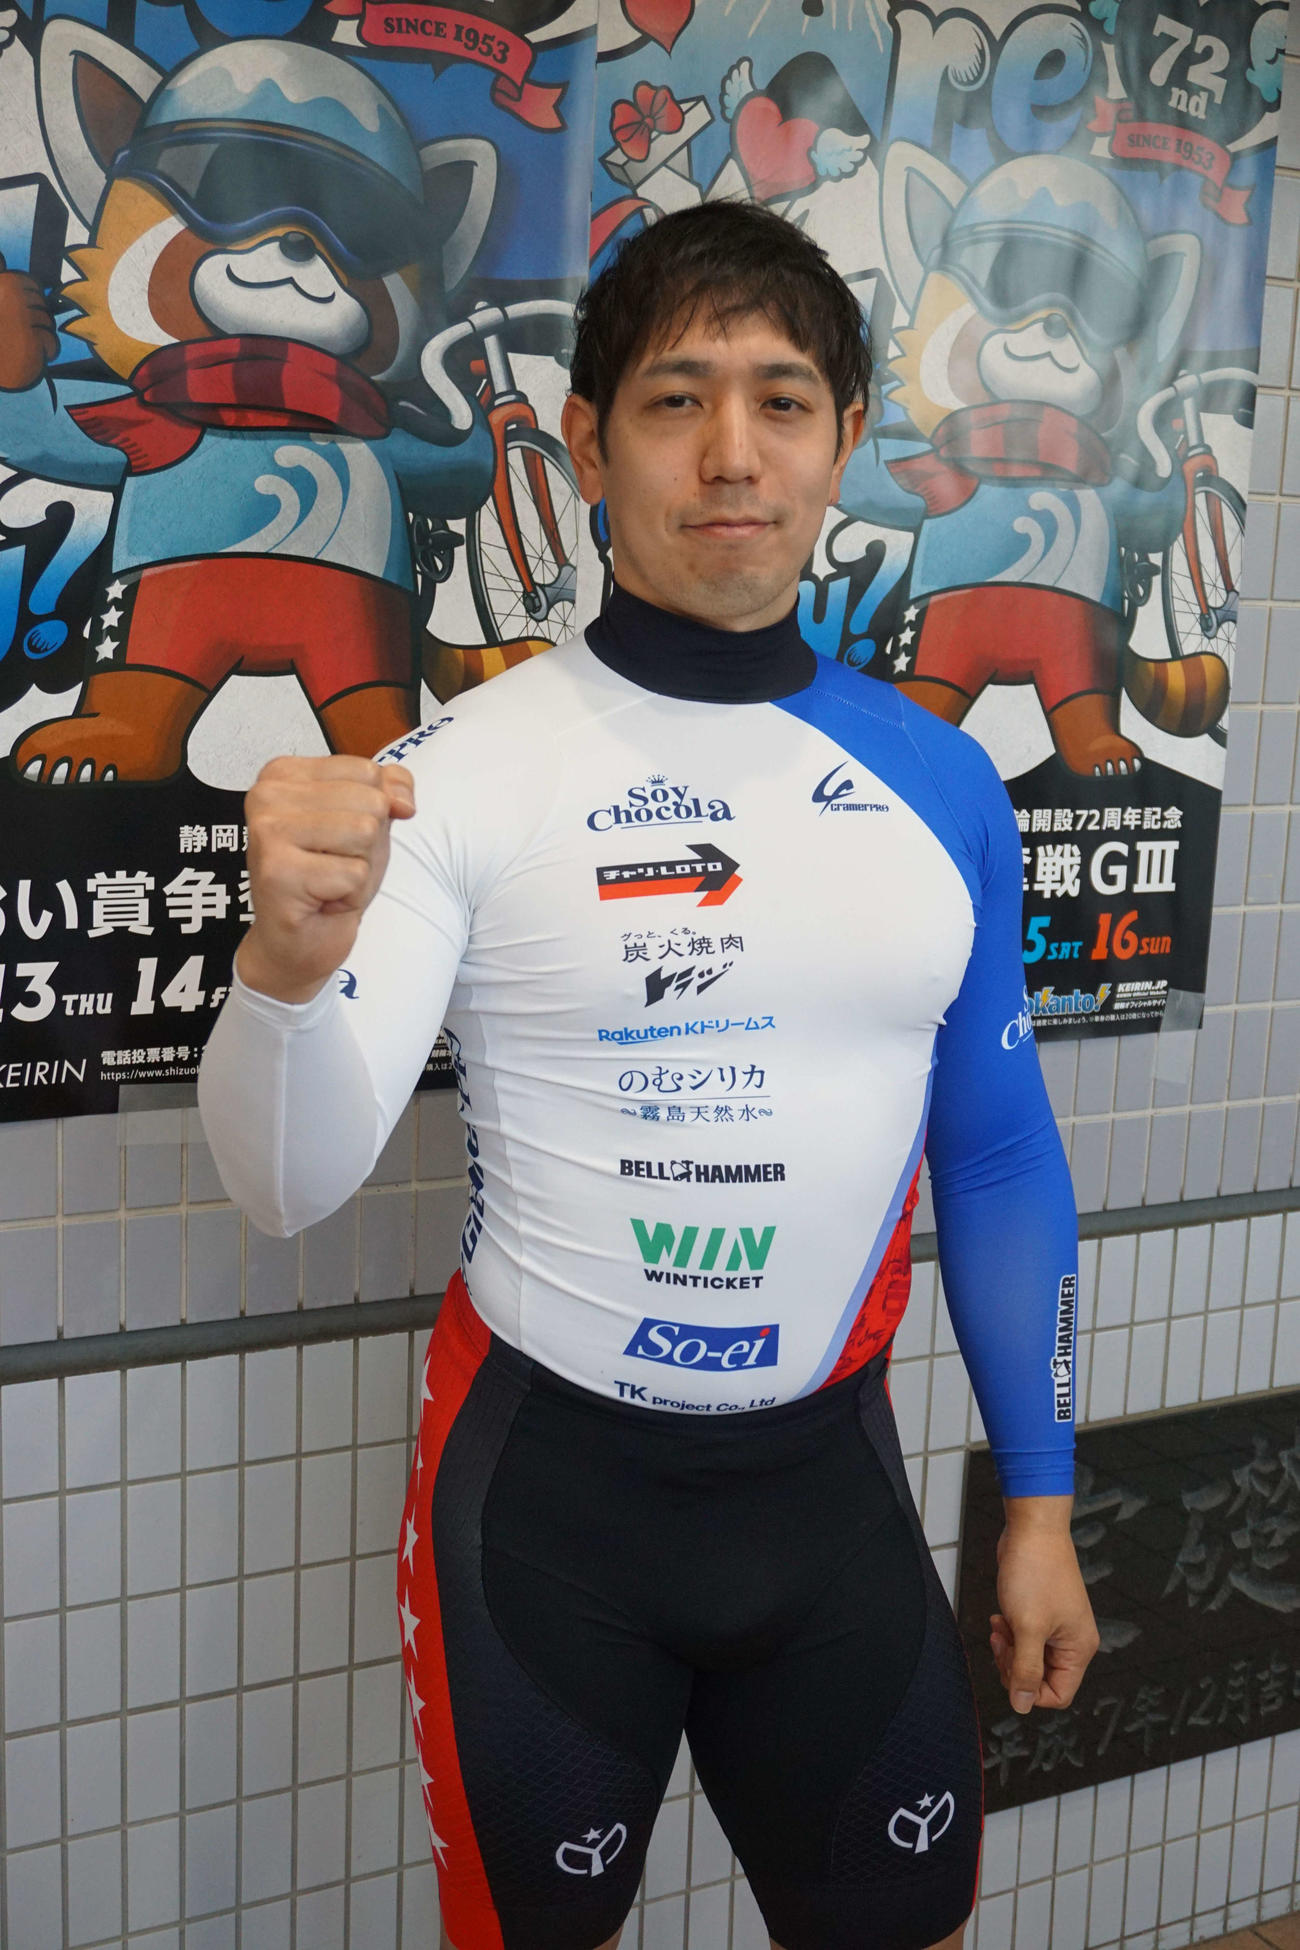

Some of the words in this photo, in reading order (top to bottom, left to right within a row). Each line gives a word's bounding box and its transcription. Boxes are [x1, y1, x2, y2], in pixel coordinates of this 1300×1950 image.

[383, 17, 448, 39] SINCE
[454, 24, 511, 64] 1953
[1149, 14, 1231, 104] 72
[1168, 87, 1209, 119] nd
[1127, 133, 1171, 151] SINCE
[1175, 138, 1216, 171] 1953
[627, 784, 690, 808] Soy
[586, 797, 737, 832] Chocola
[178, 824, 249, 853] 静岡
[0, 867, 256, 940] い賞争
[622, 933, 745, 963] 炭火焼肉
[1091, 910, 1139, 961] 16
[61, 993, 114, 1016] THU
[130, 954, 206, 1015] 14
[644, 961, 734, 1008] トラジ
[1117, 980, 1168, 993] KEIRIN.JP
[598, 1025, 682, 1042] Rakuten
[685, 1016, 776, 1036] Kドリームス
[618, 1064, 766, 1094] のむシリカ
[620, 1158, 671, 1181] BELL
[694, 1163, 786, 1183] HAMMER
[630, 1217, 777, 1271] WIN
[643, 1268, 764, 1290] WINTICKET
[1056, 1275, 1076, 1358] HAMMER
[636, 1323, 771, 1369] So-ei
[614, 1379, 648, 1402] TK
[652, 1395, 712, 1413] project
[749, 1396, 777, 1409] Ltd
[1056, 1377, 1072, 1421] BELL
